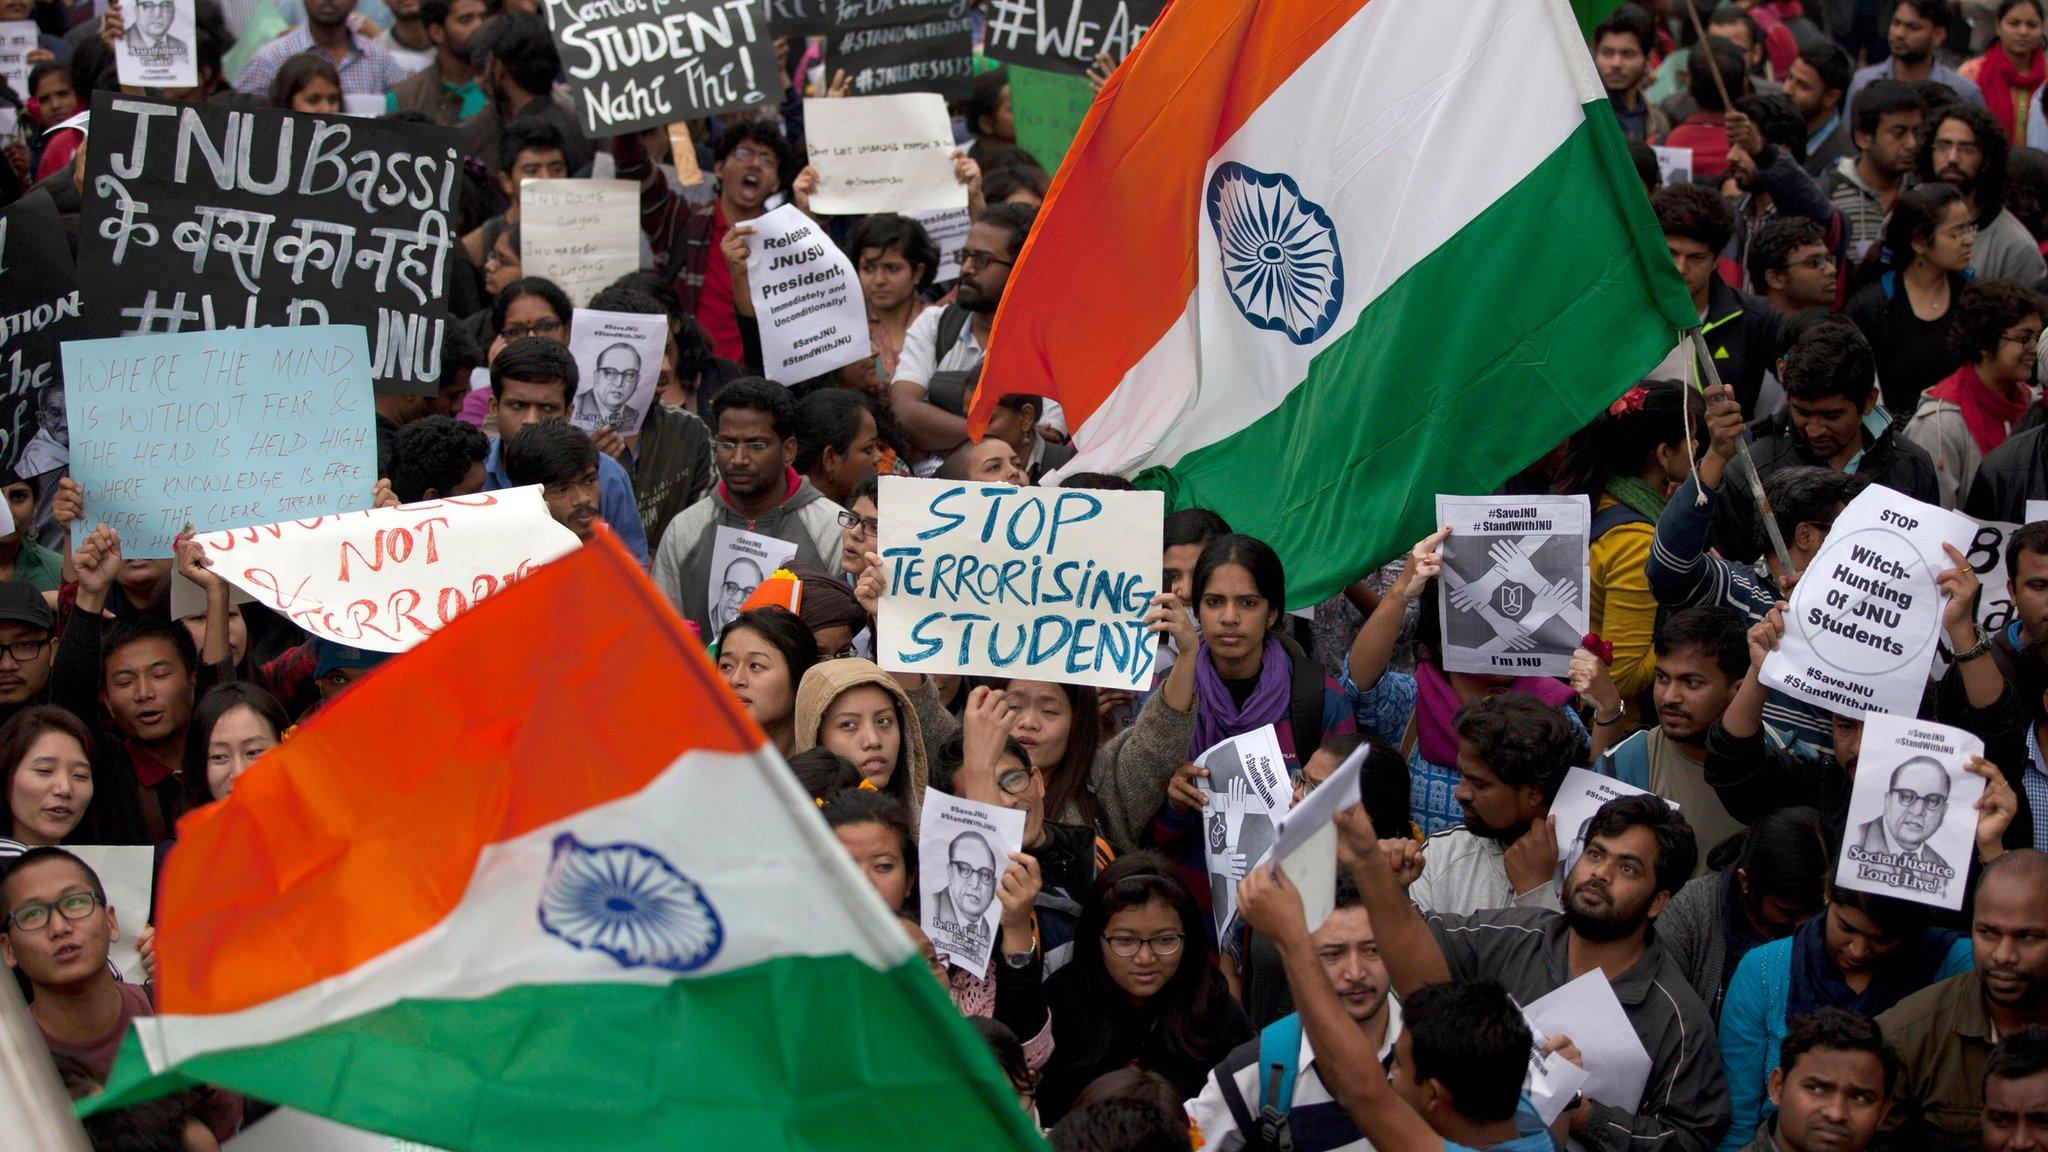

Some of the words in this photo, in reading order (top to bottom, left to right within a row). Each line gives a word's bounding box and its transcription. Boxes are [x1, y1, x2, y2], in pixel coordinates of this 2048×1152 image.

[561, 1, 757, 79] STUDENT
[583, 75, 672, 131] Nahi
[674, 45, 765, 109] Thi!
[111, 99, 294, 196] JNU
[298, 119, 457, 213] Bassi
[95, 175, 160, 266] के
[763, 225, 812, 251] Release
[769, 243, 825, 272] JNUSU
[762, 262, 845, 300] President,
[770, 289, 826, 315] Immediately
[828, 282, 847, 295] and
[774, 295, 847, 328] Unconditionally!
[593, 330, 647, 341] #StandWithJNU
[604, 323, 640, 333] #SaveJNU
[792, 325, 837, 350] #SaveJNU
[782, 335, 853, 368] #StandWithJNU
[78, 353, 181, 395] WHERE
[195, 347, 251, 387] THE
[270, 345, 354, 378] MIND
[80, 406, 101, 433] IS
[119, 393, 248, 434] WITHOUT
[262, 389, 317, 422] FEAR
[328, 377, 358, 417] &
[78, 440, 119, 470] THE
[132, 440, 196, 470] HEAD
[212, 435, 232, 459] IS
[246, 431, 309, 459] HELD
[80, 477, 146, 503] WHERE
[162, 470, 284, 501] KNOWLEDGE
[300, 467, 313, 485] IS
[160, 505, 193, 532] THE
[207, 501, 267, 526] CLEAR
[277, 495, 331, 516] STREAM
[337, 493, 361, 510] OF
[915, 486, 1103, 555] STOP
[1488, 507, 1538, 519] #SaveJNU
[1879, 509, 1919, 532] STOP
[337, 517, 450, 583] NOT
[1850, 544, 1911, 580] Witch-
[882, 547, 1157, 619] TERRORISING
[1831, 563, 1913, 611] Hunting
[1852, 600, 1902, 629] JNU
[897, 611, 1160, 686] STUDENTS
[1807, 607, 1905, 657] Students
[1491, 655, 1513, 667] I'm
[1516, 656, 1542, 668] JNU
[1806, 666, 1875, 698] #SaveJNU
[1894, 737, 1955, 755] #StandWithJNU
[1907, 729, 1946, 743] #SaveJNU
[940, 812, 997, 833] #StandWithJNU
[950, 804, 988, 820] #SaveJNU
[1847, 846, 1899, 868] Social
[1898, 854, 1955, 879] Justice
[1857, 863, 1901, 886] Long
[1903, 870, 1940, 894] Live!
